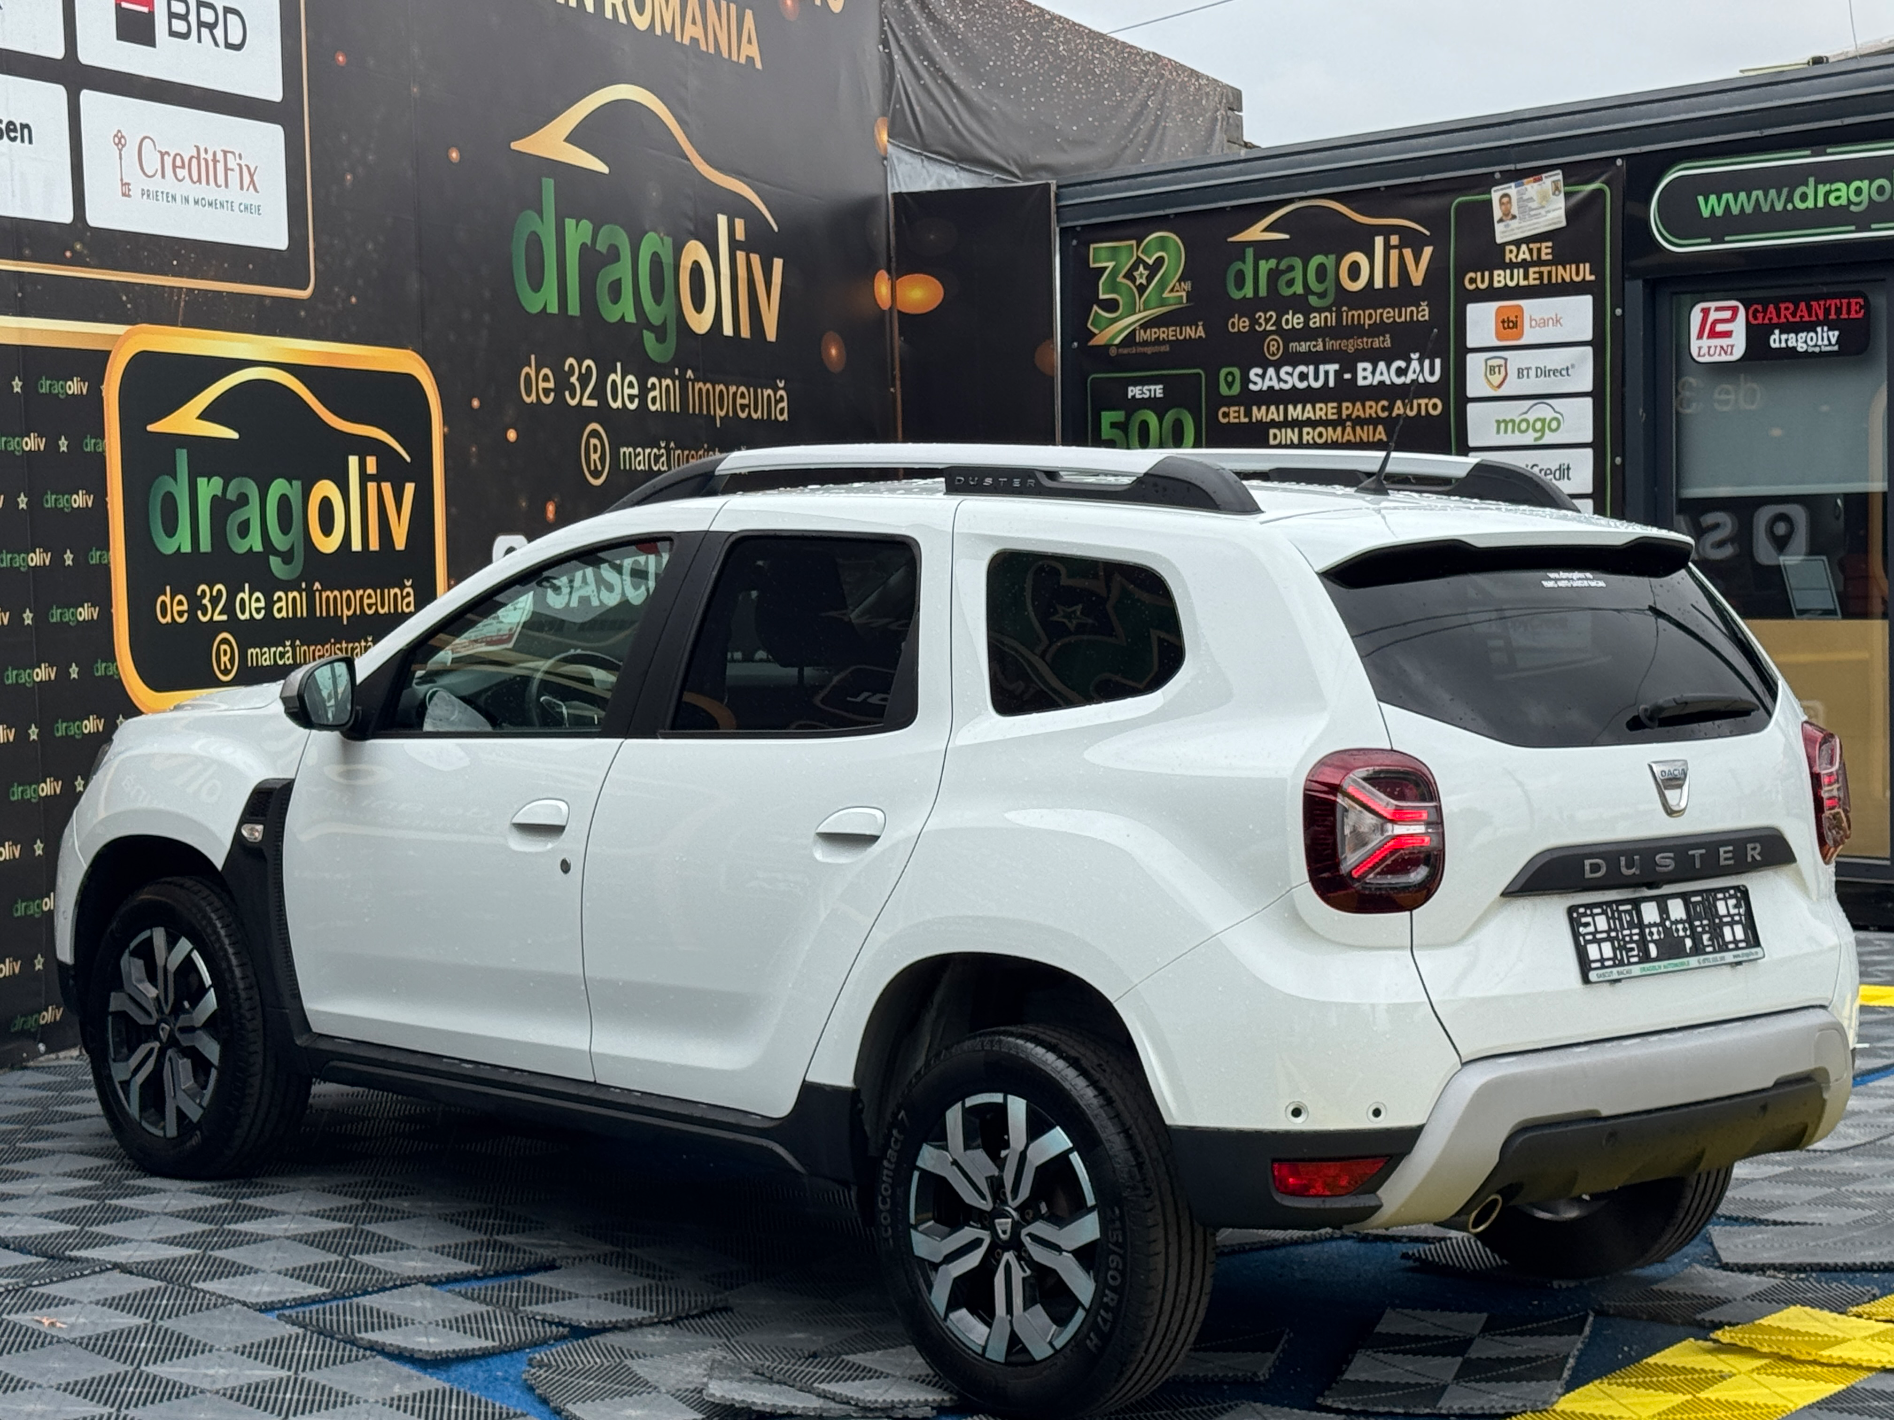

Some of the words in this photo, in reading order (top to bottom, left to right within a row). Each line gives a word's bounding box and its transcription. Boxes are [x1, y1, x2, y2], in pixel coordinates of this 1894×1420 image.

[167, 0, 248, 52] BRD
[137, 136, 260, 194] CreditFix
[141, 188, 177, 205] PRIETEN
[180, 194, 190, 206] IN
[193, 199, 235, 212] MOMENTE
[238, 202, 262, 216] CHEIE
[1505, 243, 1553, 263] RATE
[511, 177, 784, 362] dragoliv
[1087, 231, 1187, 334] 32
[1226, 234, 1434, 308] dragoliv
[1464, 270, 1490, 290] CU
[1493, 264, 1596, 288] BULETINUL
[1228, 315, 1250, 333] de
[1255, 312, 1276, 331] 32
[1281, 310, 1304, 329] de
[1309, 307, 1336, 327] ani
[1341, 301, 1430, 329] împreună
[1501, 315, 1519, 331] tbi
[1529, 313, 1563, 330] bank
[1696, 305, 1739, 341] 12
[1748, 298, 1865, 325] GARANTIE
[1289, 339, 1323, 352] marcă
[1326, 333, 1391, 353] înregistrată
[1696, 344, 1735, 358] LUNI
[1769, 326, 1840, 352] dragoliv
[1249, 364, 1339, 392] SASCUT
[1356, 353, 1442, 386] BACĂU
[1516, 366, 1532, 379] BT
[38, 376, 89, 399] dragoliv
[520, 354, 555, 404] de
[564, 356, 598, 407] 32
[606, 361, 640, 411] de
[647, 368, 681, 413] ani
[685, 368, 789, 427] împreună
[1127, 384, 1164, 400] PESTE
[1217, 405, 1249, 424] CEL
[1252, 403, 1284, 422] MAI
[1287, 402, 1338, 421] MARE
[1341, 400, 1389, 419] PARC
[1393, 397, 1443, 417] AUTO
[1099, 406, 1196, 450] 500
[1268, 427, 1299, 446] DIN
[1302, 422, 1388, 445] ROMÂNIA
[1494, 416, 1563, 443] mogo
[0, 432, 47, 456] ragoliv
[619, 440, 669, 472] marcă
[954, 476, 1037, 488] DUSTER
[43, 489, 95, 513] dragoliv
[149, 448, 416, 581] dragoliv
[48, 602, 100, 627] dragoliv
[156, 585, 189, 625] de
[196, 583, 228, 623] 32
[235, 583, 265, 621] de
[273, 581, 307, 619] ani
[313, 579, 416, 625] împreună
[247, 640, 294, 668] marcă
[3, 662, 58, 688] dragoliv
[54, 714, 105, 740] dragoliv
[1660, 768, 1687, 778] DACIA
[9, 776, 63, 803] dragoliv
[1583, 843, 1762, 878] DUSTER
[11, 1003, 64, 1033] dragoliv
